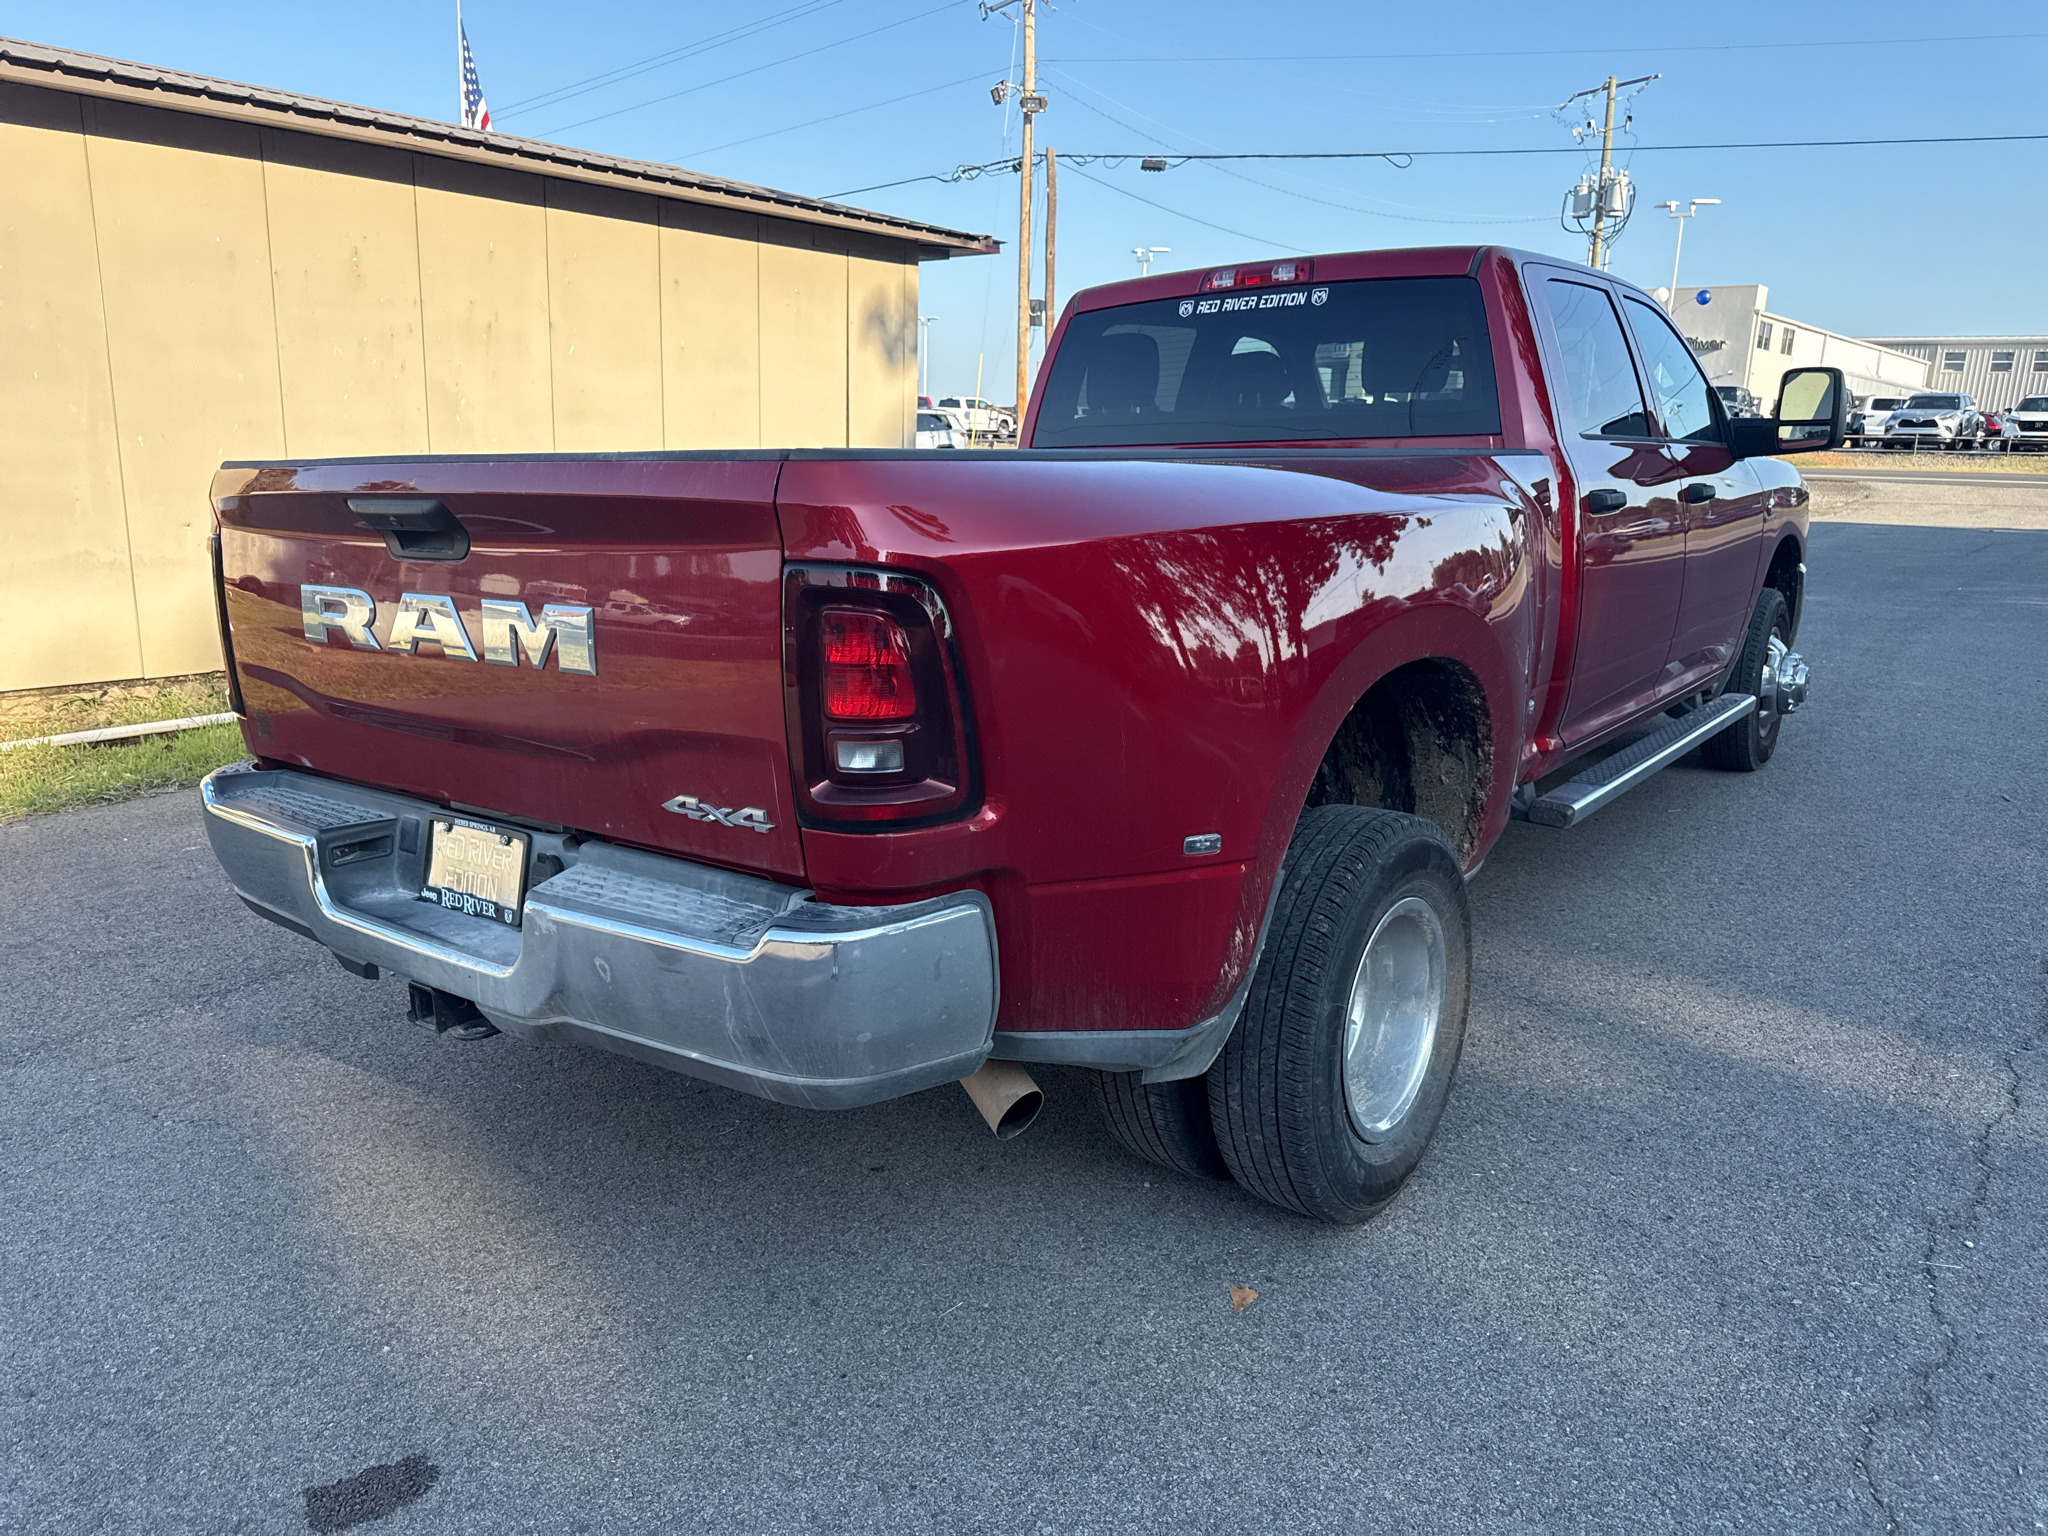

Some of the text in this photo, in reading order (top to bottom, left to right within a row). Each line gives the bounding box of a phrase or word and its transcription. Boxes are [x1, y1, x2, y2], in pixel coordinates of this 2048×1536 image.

[1196, 292, 1308, 315] RED RIVER EDITION
[301, 583, 598, 676] RAM
[437, 832, 514, 872] RED RIVER
[421, 887, 438, 902] Jeep
[444, 866, 499, 902] EDITION
